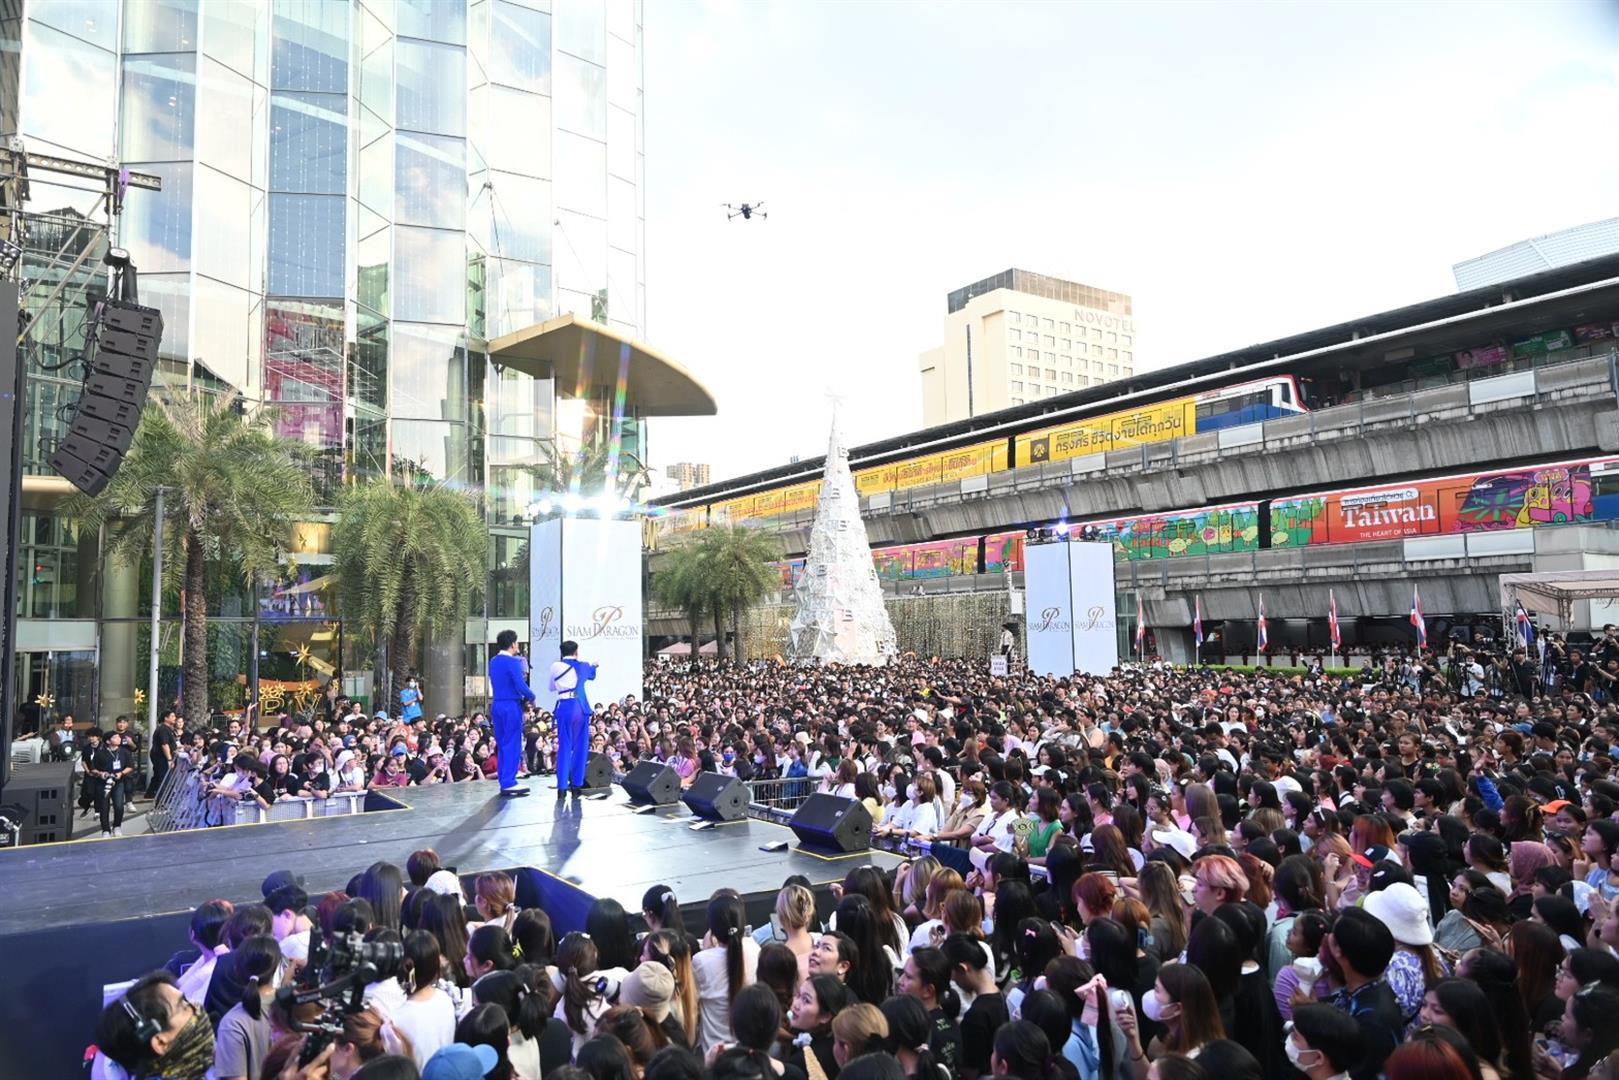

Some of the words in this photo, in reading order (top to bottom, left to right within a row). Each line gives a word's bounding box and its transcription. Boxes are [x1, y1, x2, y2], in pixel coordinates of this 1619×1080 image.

[1074, 308, 1136, 333] NOVOTEL
[1341, 503, 1436, 528] Taiwan
[567, 625, 592, 637] SIAM
[593, 622, 639, 637] PARAGON
